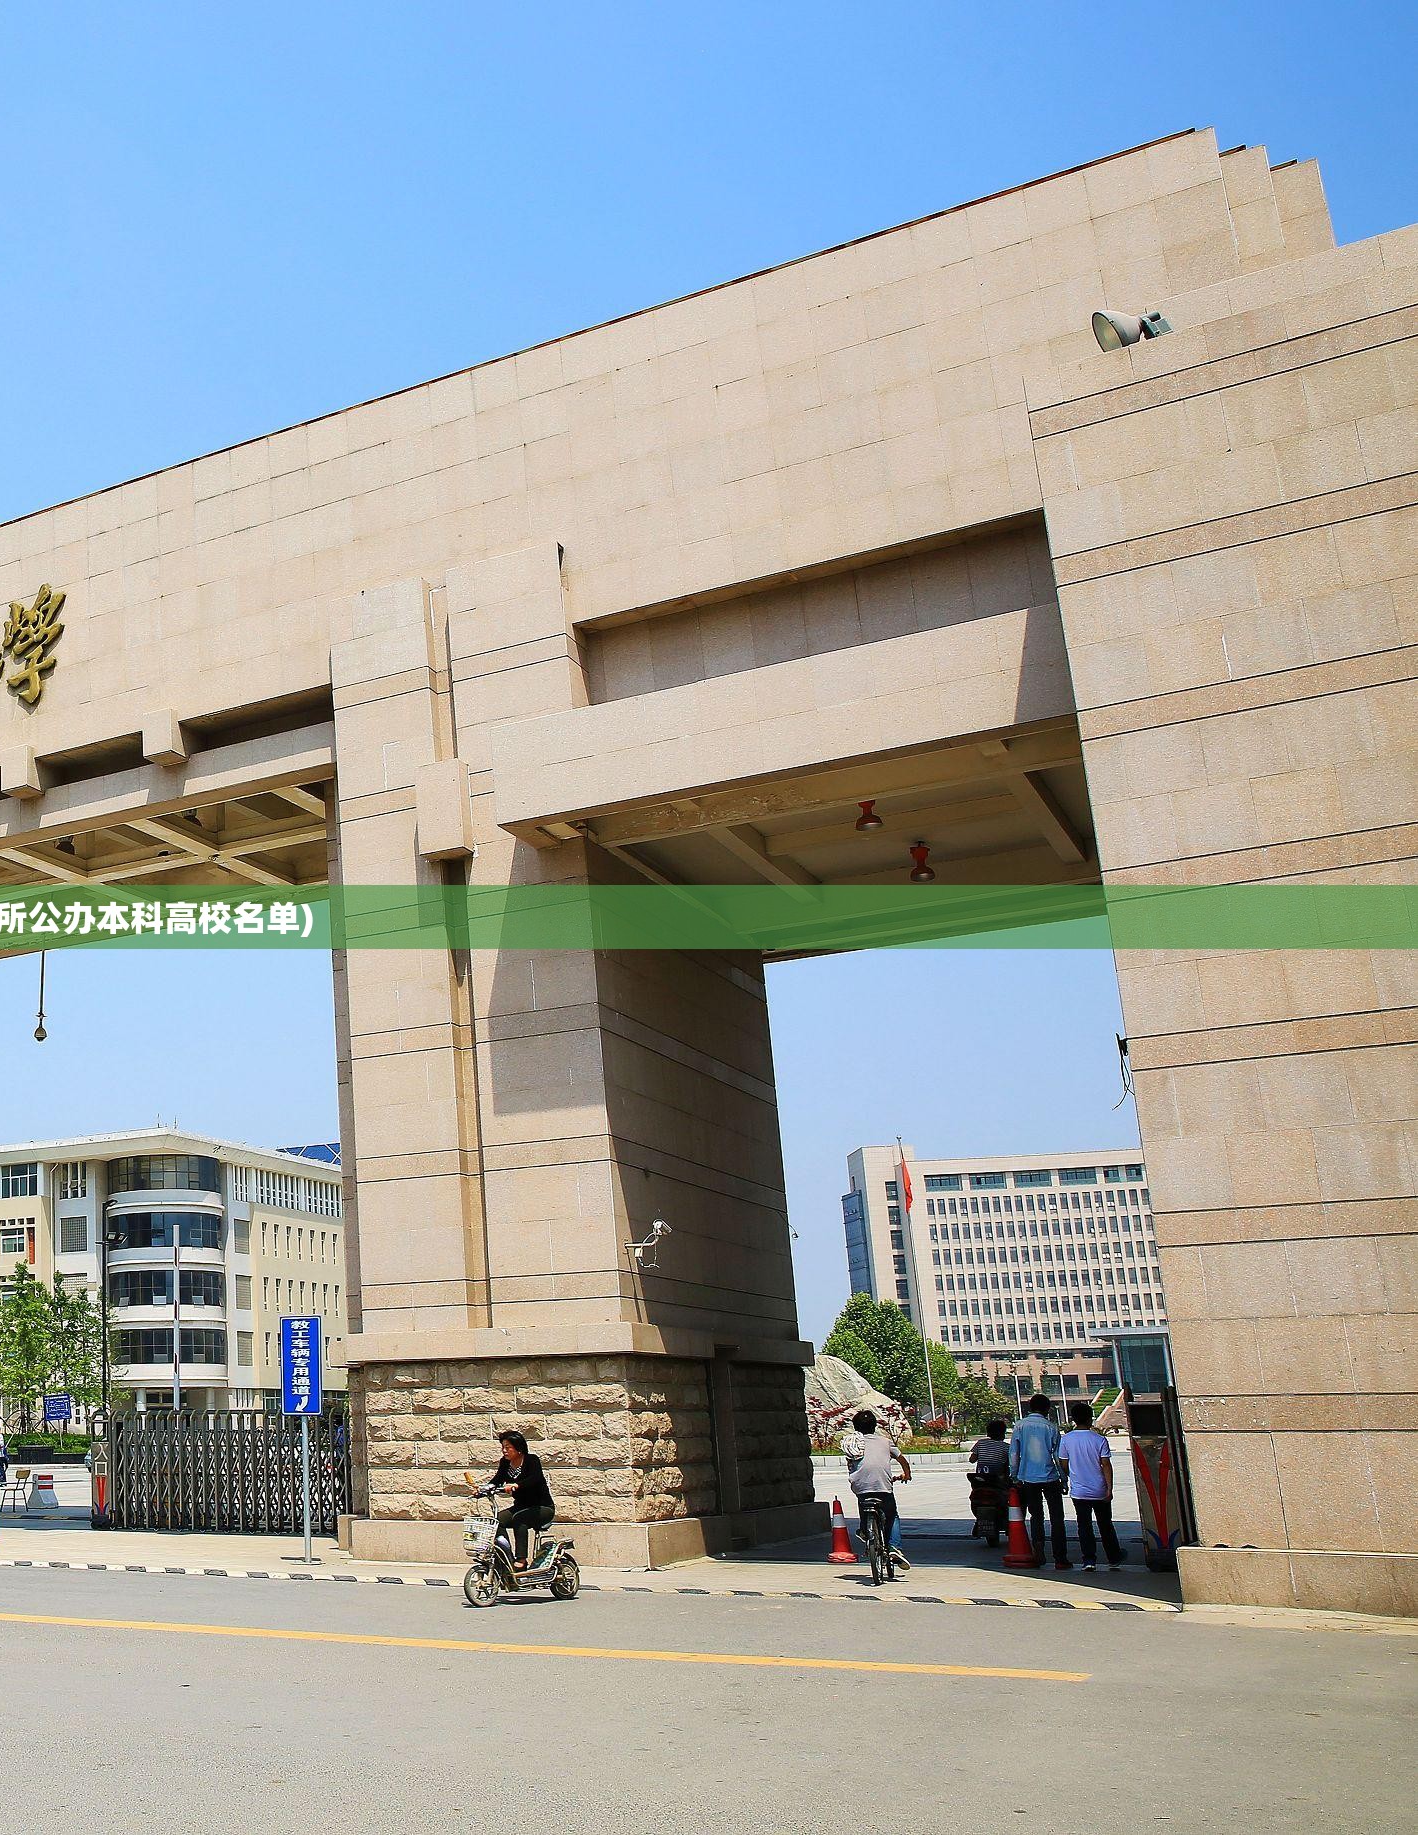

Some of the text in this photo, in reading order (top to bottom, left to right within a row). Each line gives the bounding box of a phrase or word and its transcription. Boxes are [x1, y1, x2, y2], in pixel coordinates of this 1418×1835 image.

[290, 1320, 311, 1395] 教工车辆专用通道
